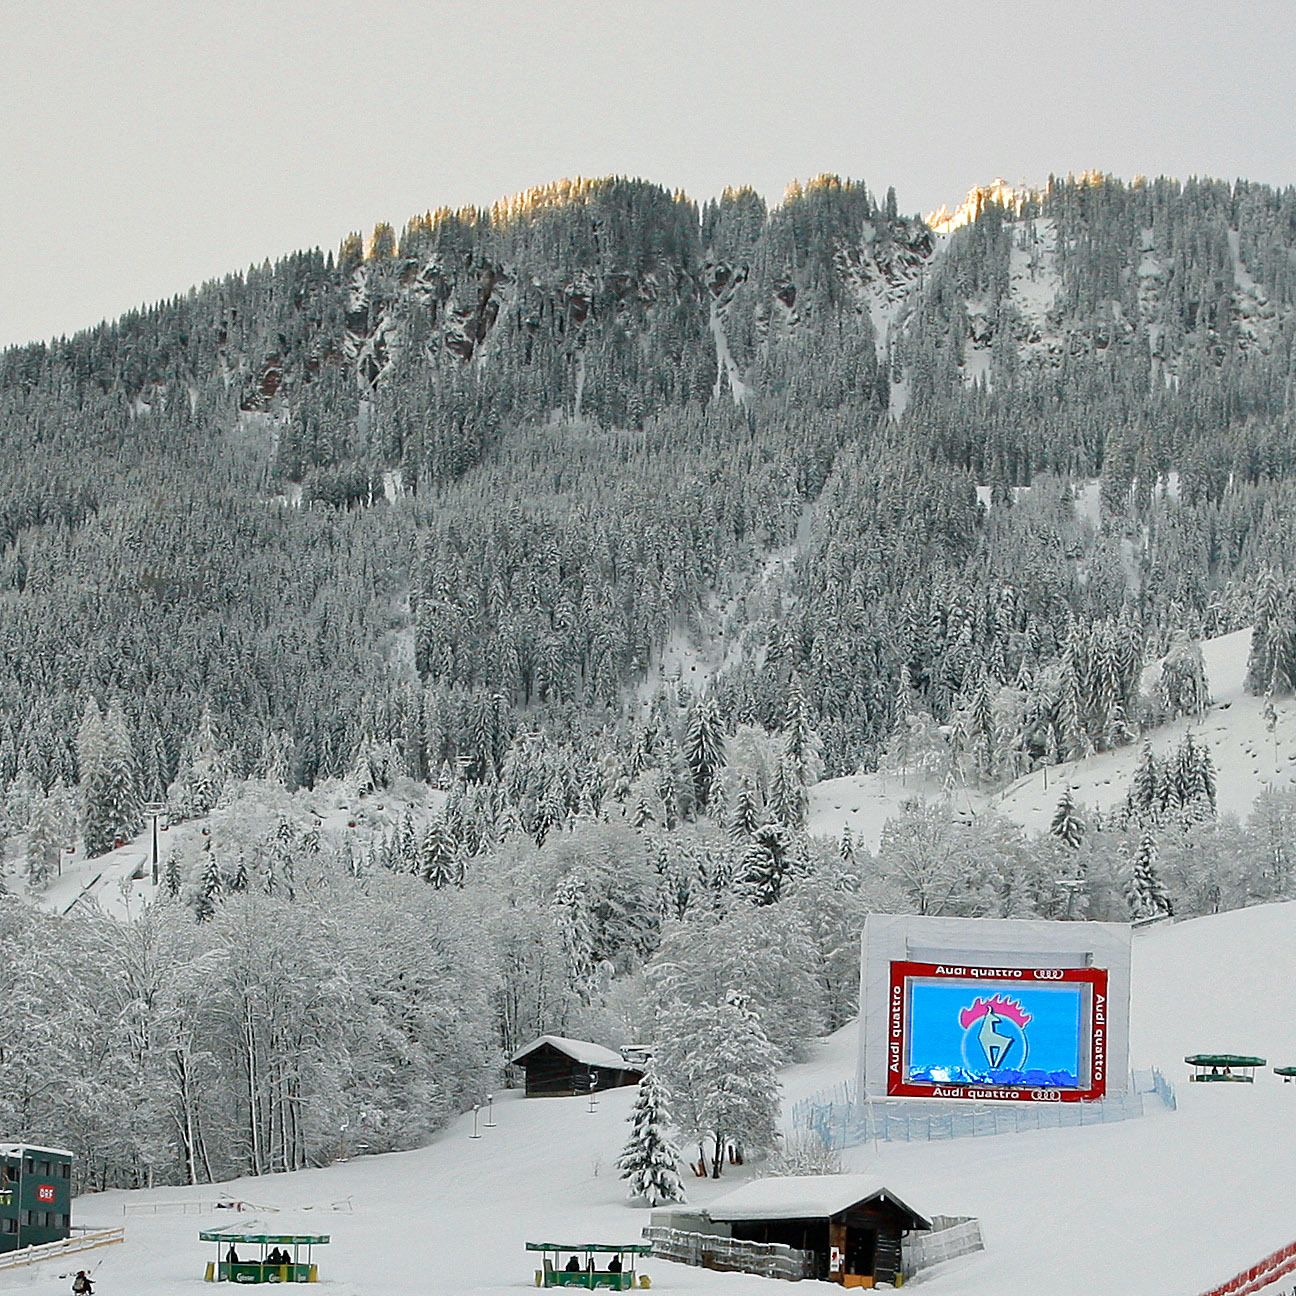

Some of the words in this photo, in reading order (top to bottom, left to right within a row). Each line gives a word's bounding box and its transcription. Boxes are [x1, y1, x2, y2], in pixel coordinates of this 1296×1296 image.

[935, 965, 966, 975] Audi
[971, 967, 1022, 978] quattro
[891, 986, 902, 1038] quattro
[1095, 993, 1105, 1024] Audi
[889, 1042, 900, 1073] Audi
[1094, 1030, 1105, 1081] quattro
[933, 1088, 964, 1098] Audi
[967, 1090, 1019, 1101] quattro
